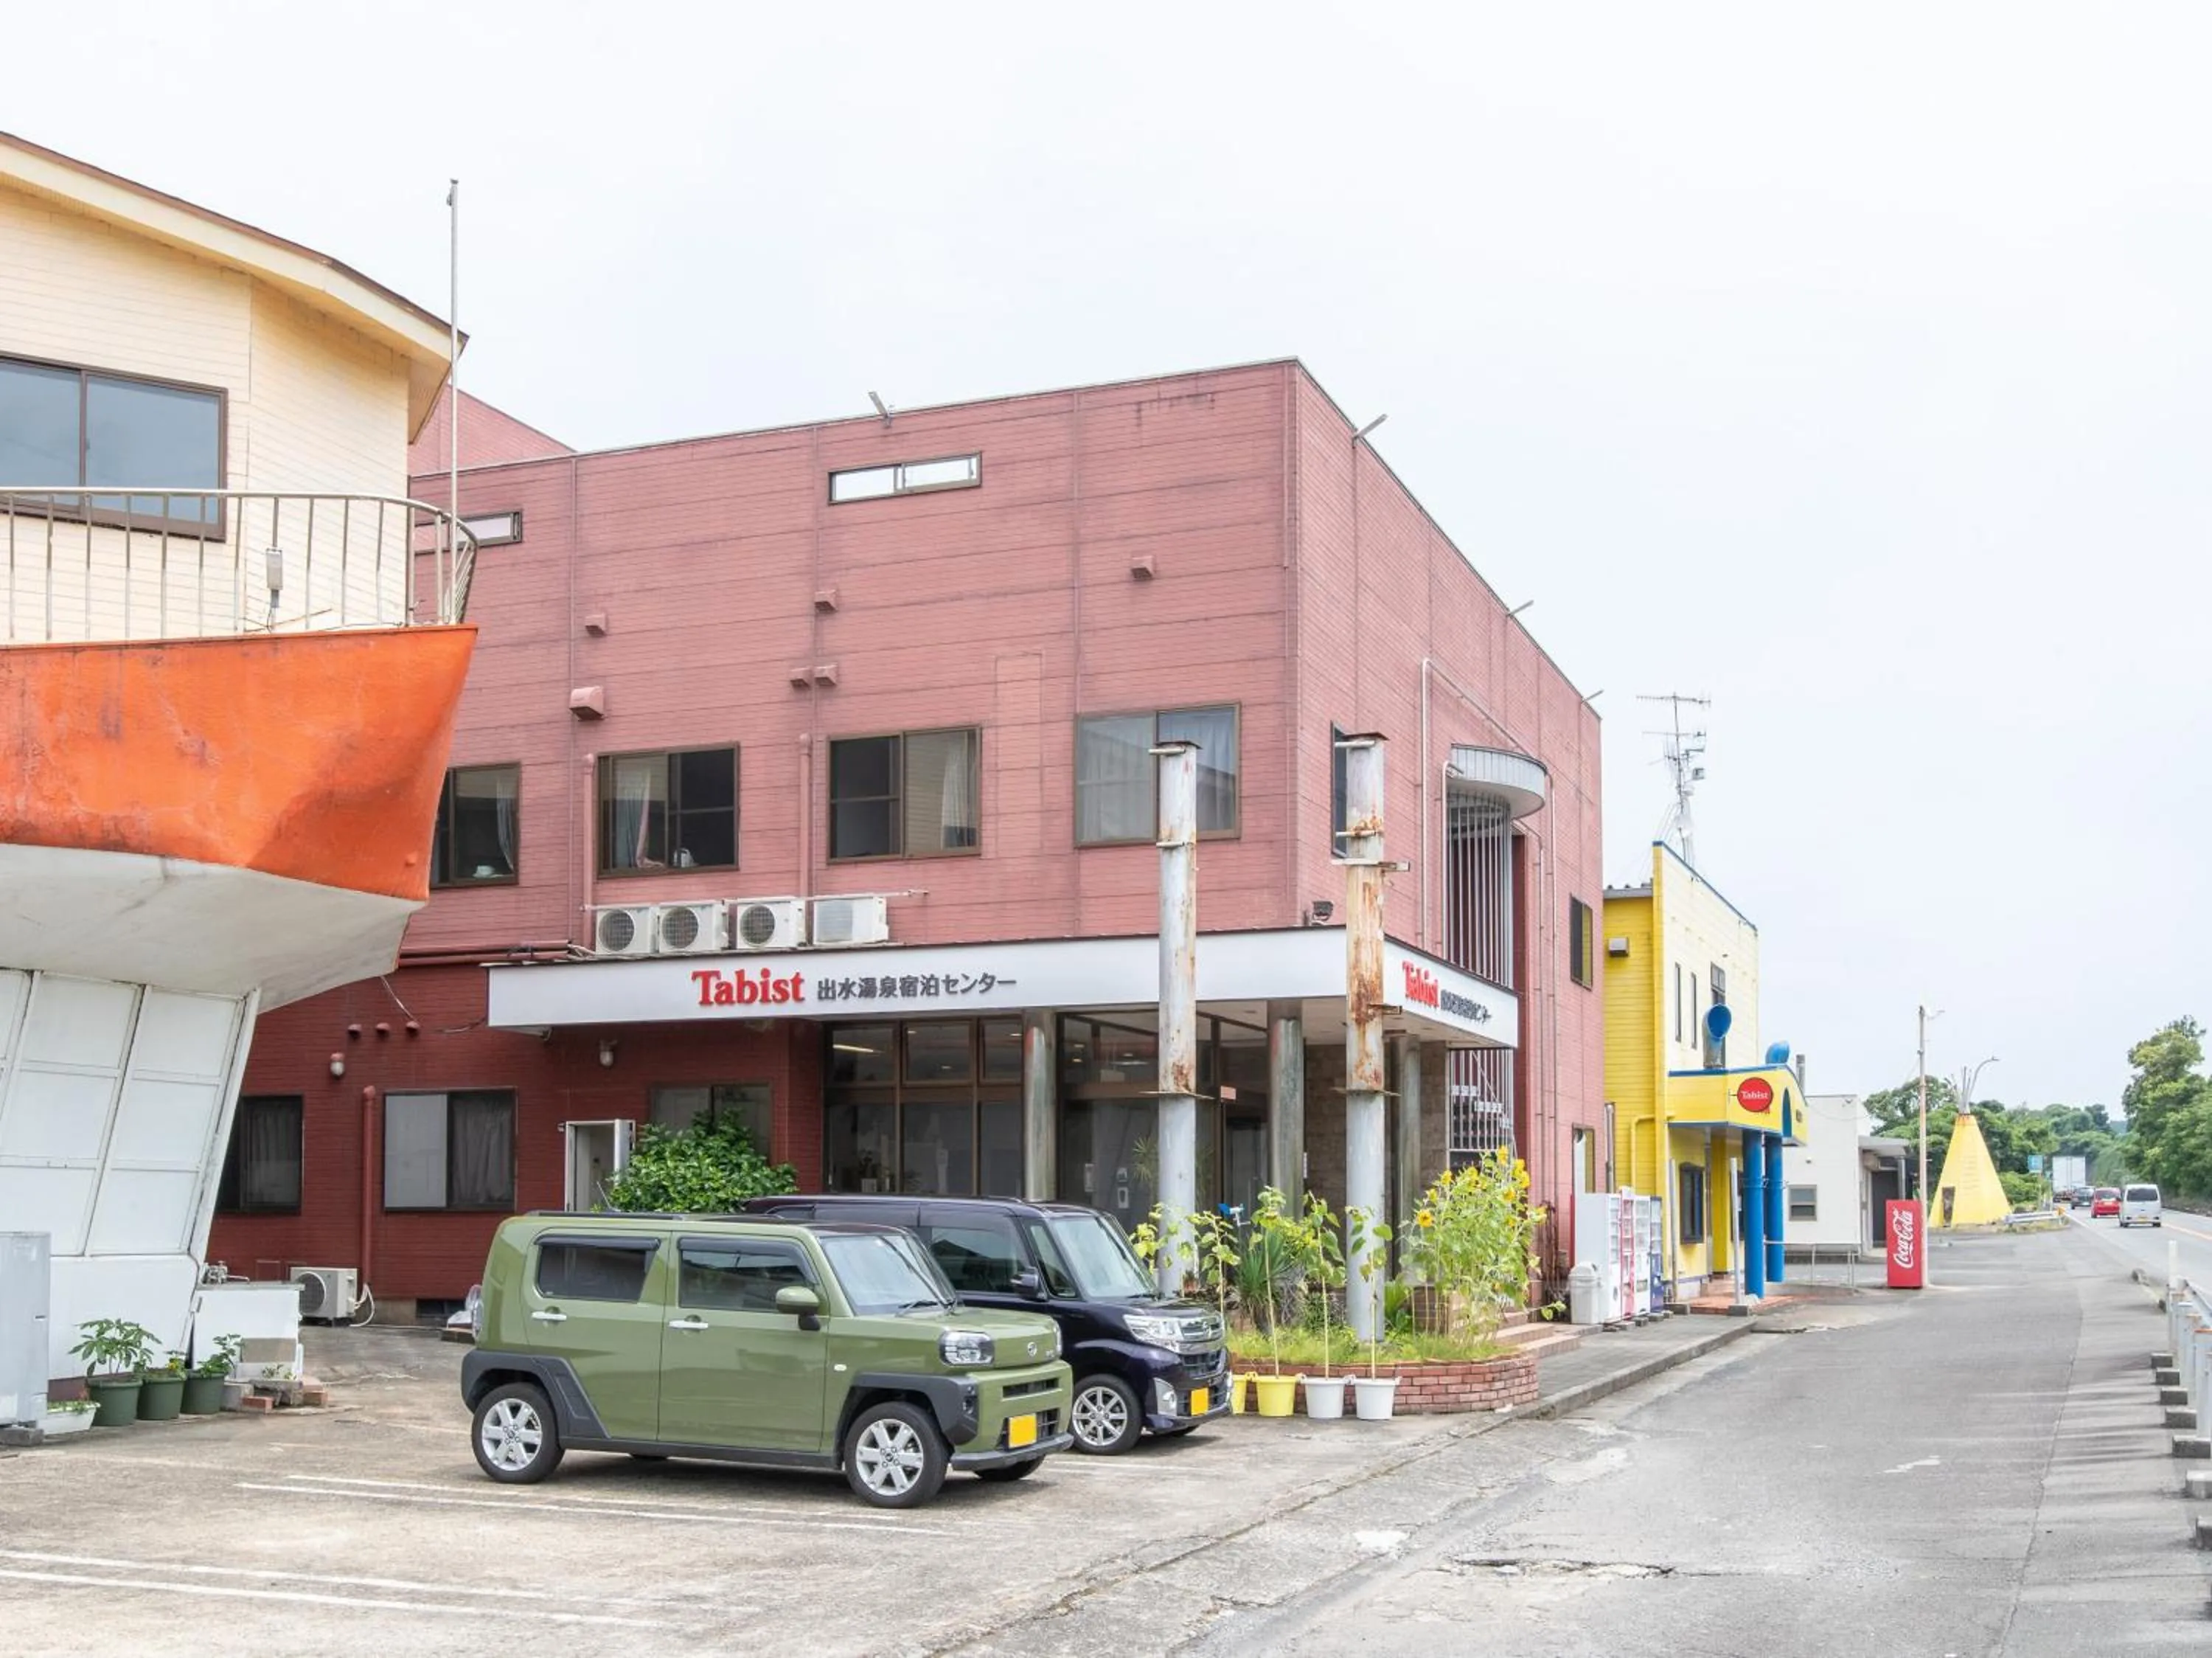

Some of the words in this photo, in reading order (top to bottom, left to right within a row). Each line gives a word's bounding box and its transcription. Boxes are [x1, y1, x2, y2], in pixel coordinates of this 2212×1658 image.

[692, 968, 804, 1006] Tabist
[817, 972, 1017, 1000] 出水湯泉宿泊センター
[1402, 960, 1439, 1007] Tabist
[1741, 1090, 1768, 1099] Tabist
